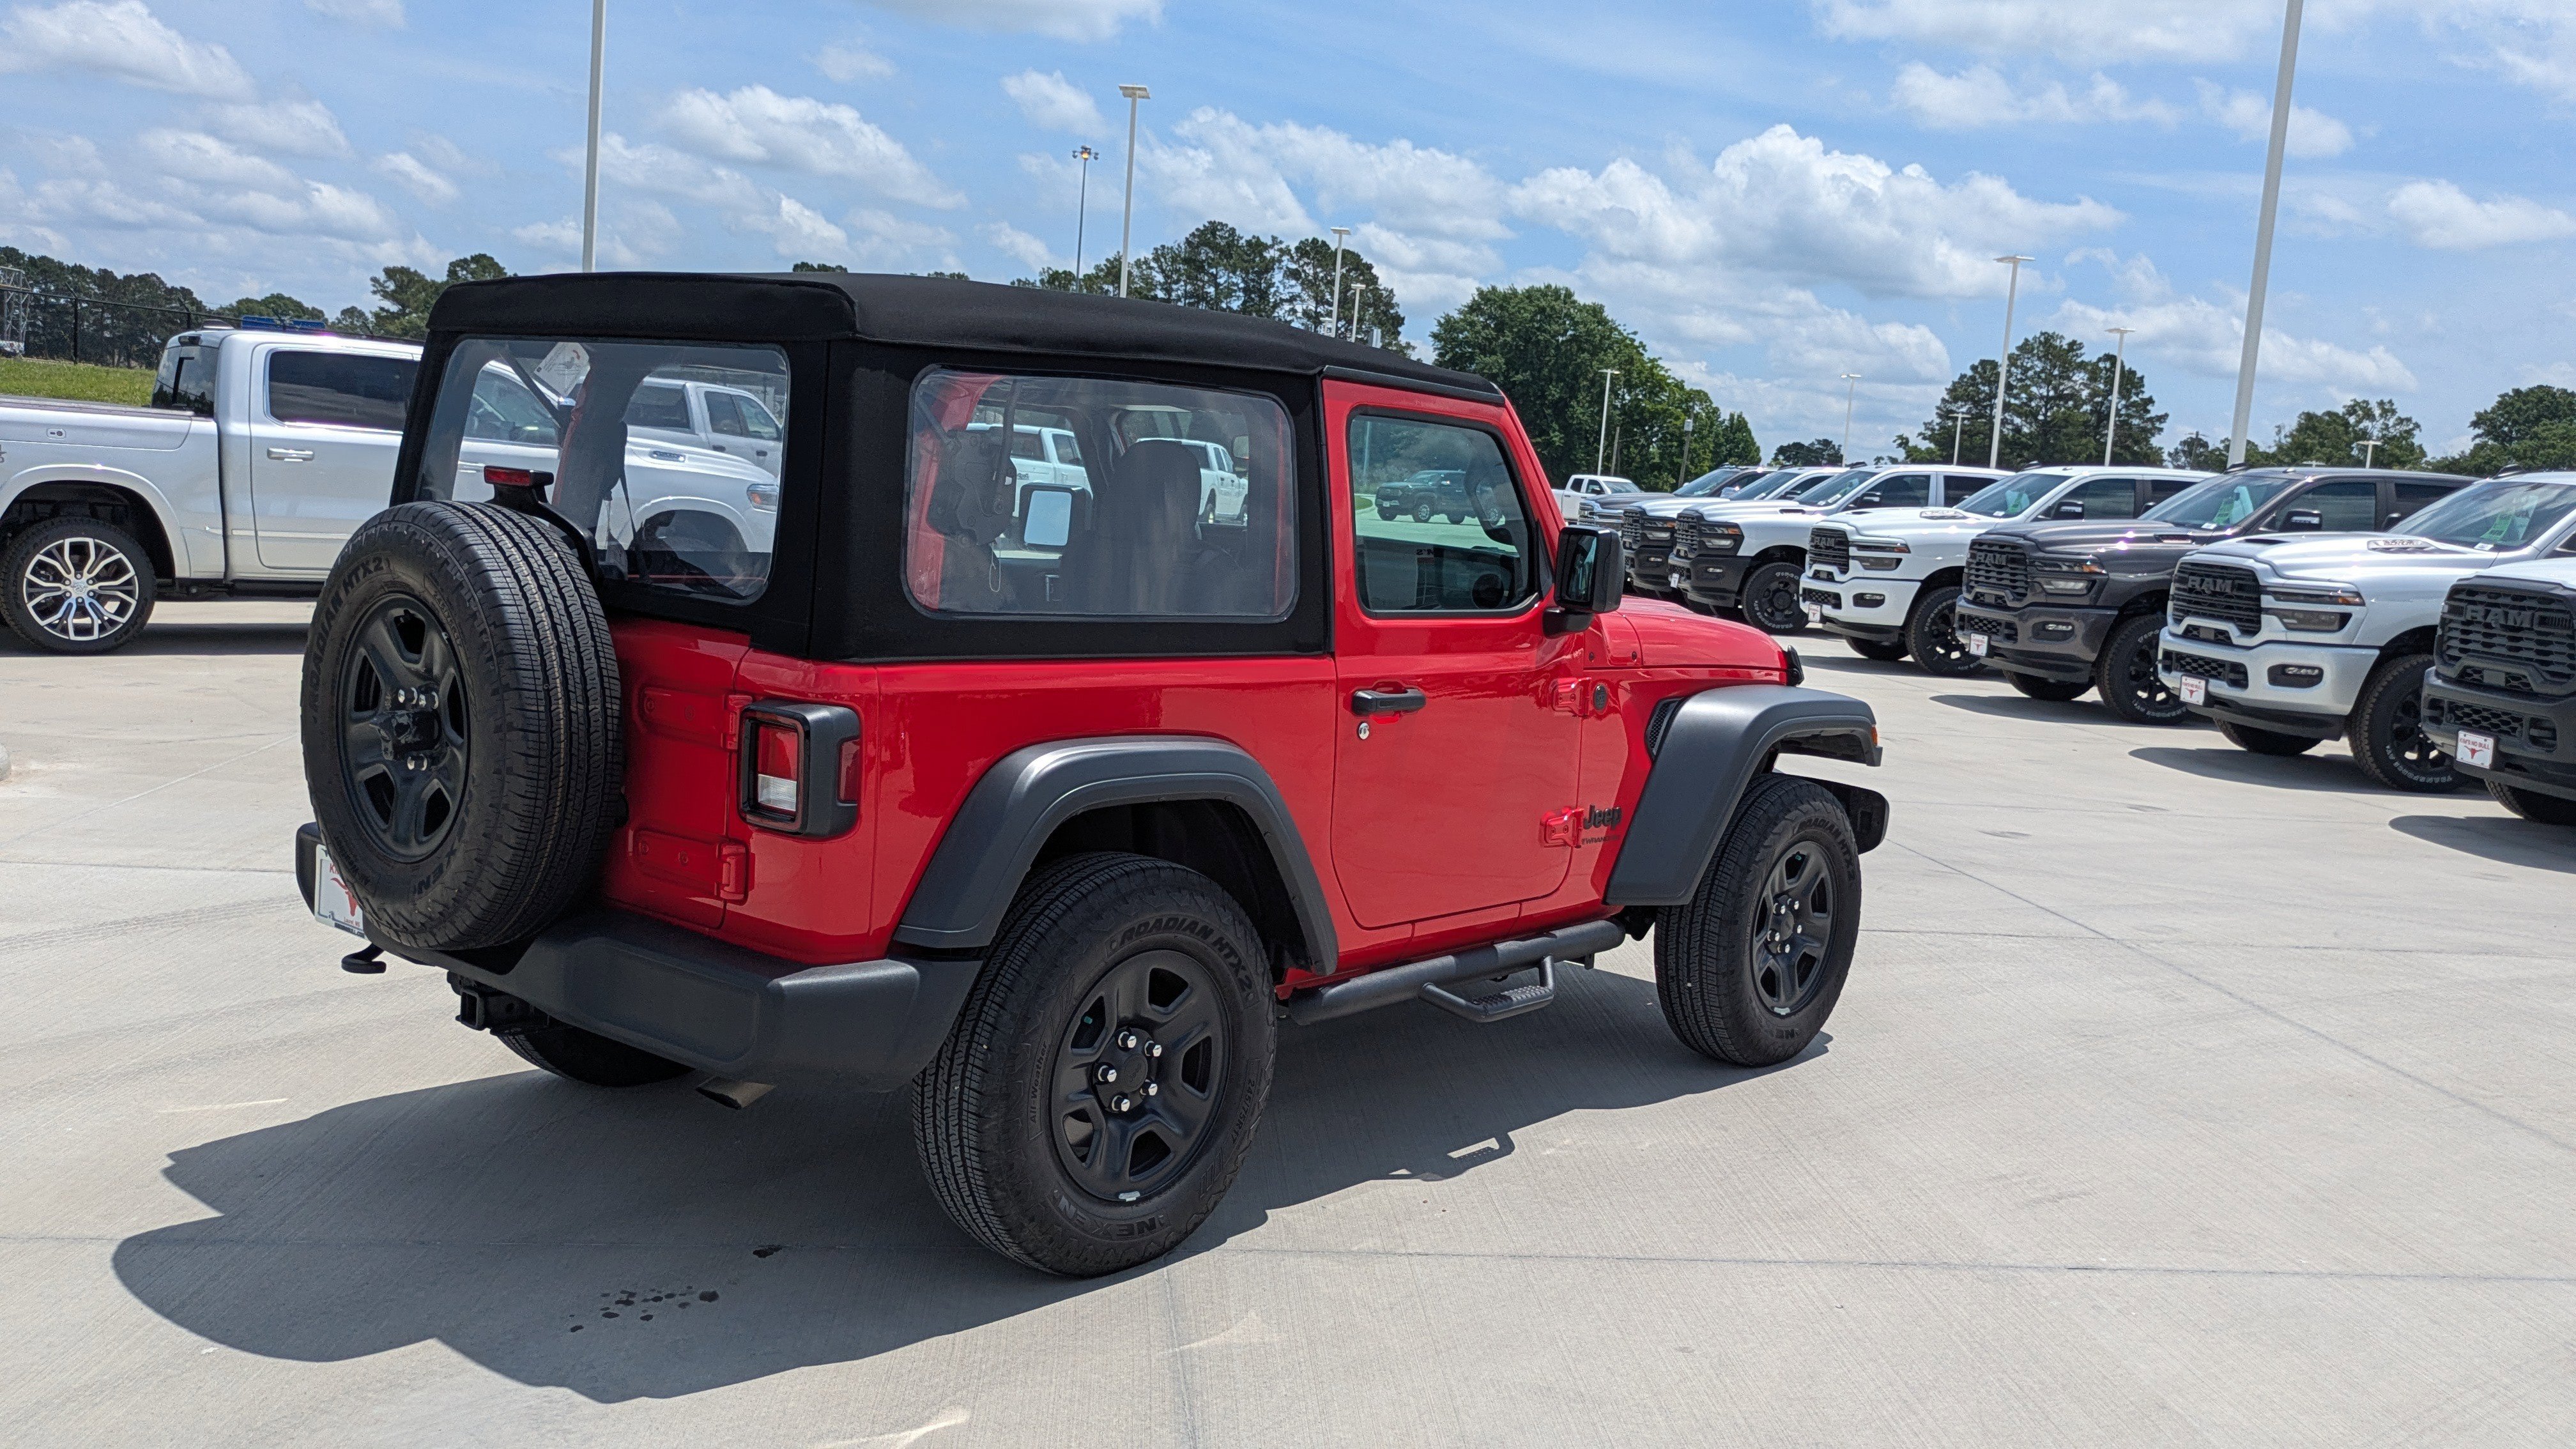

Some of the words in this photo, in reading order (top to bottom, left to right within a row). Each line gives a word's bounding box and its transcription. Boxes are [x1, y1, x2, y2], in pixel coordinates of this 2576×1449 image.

[1814, 536, 1836, 548] RAM
[1976, 551, 2007, 565] RAM
[342, 555, 385, 594] HTX2
[2188, 576, 2234, 594] RAM
[2465, 604, 2534, 629] RAM
[2393, 761, 2453, 784] TRANSFORCE
[1583, 803, 1622, 830] Jeep
[1119, 917, 1215, 947] ROADIAN
[1211, 936, 1254, 992] HTX2
[1029, 1040, 1048, 1124] All-Weather
[1230, 1078, 1255, 1145] 245/75R17
[1058, 1195, 1157, 1237] NEXEN
